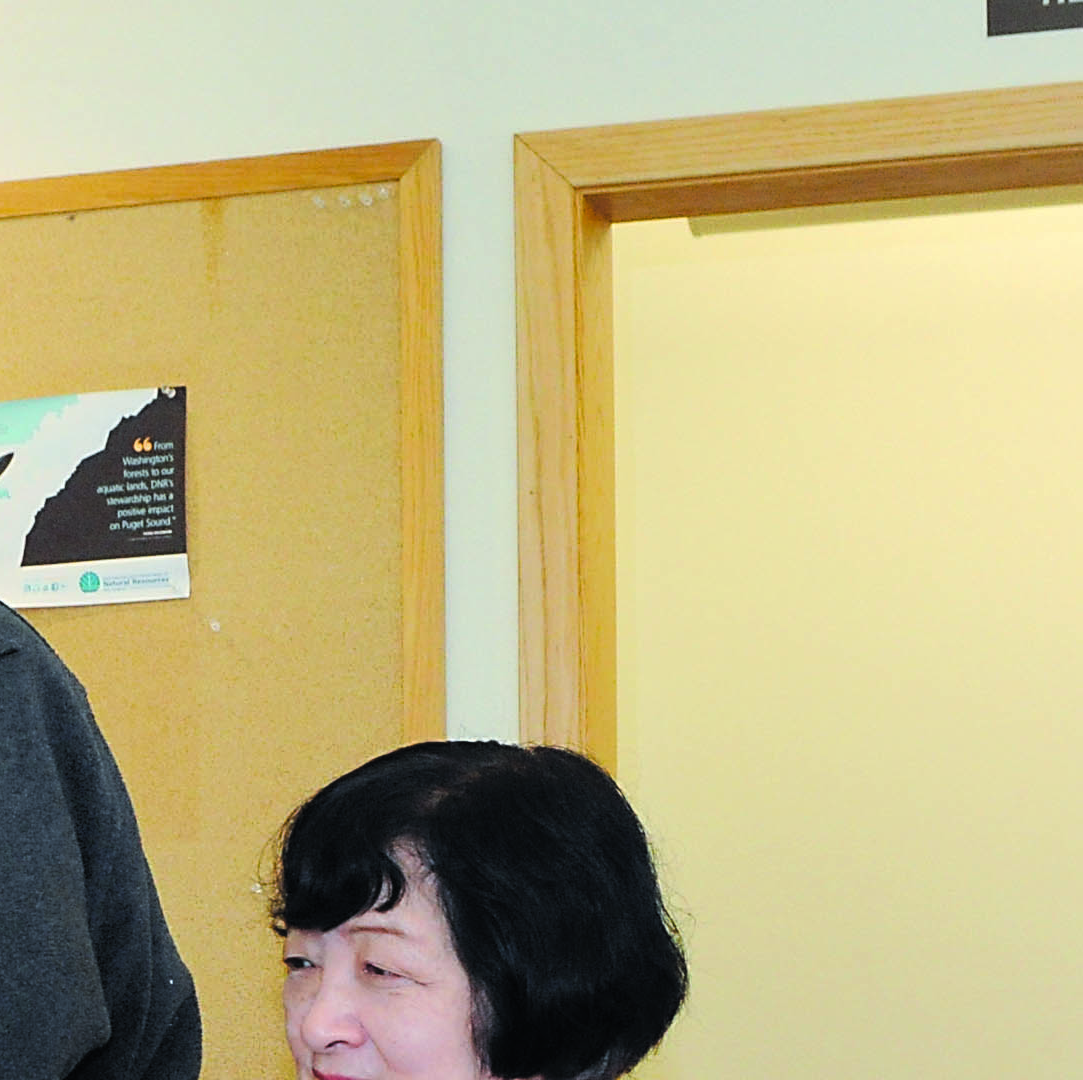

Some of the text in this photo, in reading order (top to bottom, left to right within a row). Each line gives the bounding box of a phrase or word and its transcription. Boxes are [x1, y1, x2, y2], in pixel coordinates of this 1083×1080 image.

[122, 454, 174, 466] Washington's
[123, 467, 174, 479] forests to our
[96, 484, 124, 495] aquatic
[106, 494, 152, 506] stewardship
[153, 492, 166, 502] has
[117, 504, 174, 519] positive impact
[109, 522, 120, 531] on
[122, 519, 144, 531] Puget
